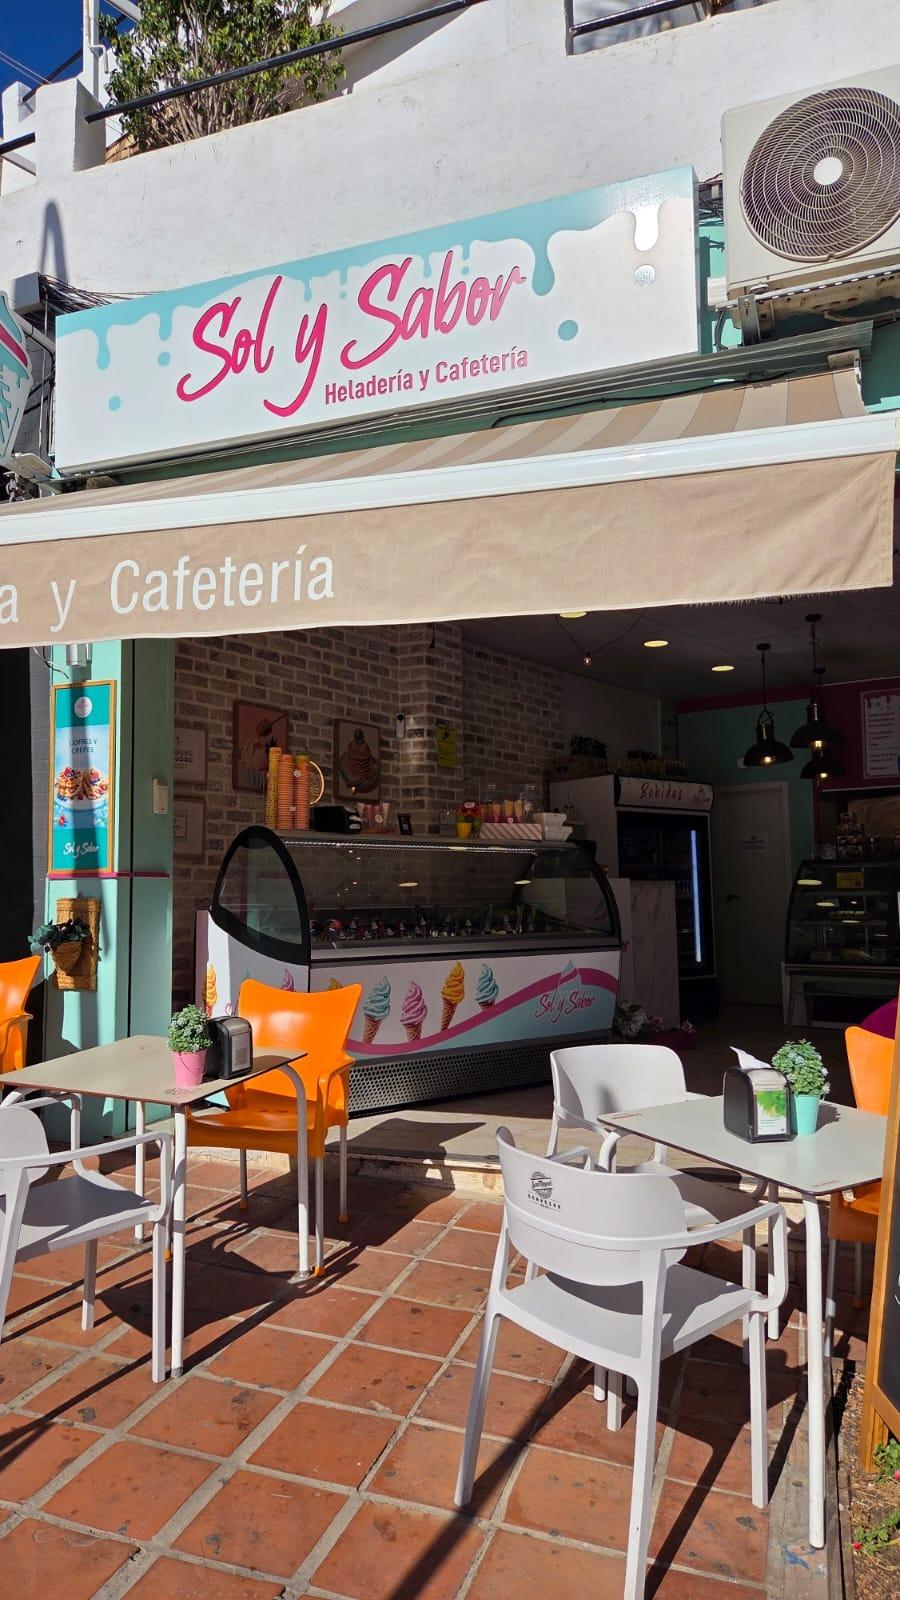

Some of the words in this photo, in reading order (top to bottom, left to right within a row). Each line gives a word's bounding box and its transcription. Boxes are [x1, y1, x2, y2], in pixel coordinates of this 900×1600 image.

[177, 275, 283, 402] Sol
[263, 303, 328, 418] y
[340, 250, 526, 371] Sabor
[325, 368, 413, 405] Heladería
[419, 371, 430, 391] y
[435, 346, 528, 384] Cafetería
[50, 579, 77, 633] y
[110, 543, 335, 615] Cafetería
[640, 782, 684, 801] Bebidas
[551, 998, 564, 1024] y
[565, 990, 595, 1014] Sabor
